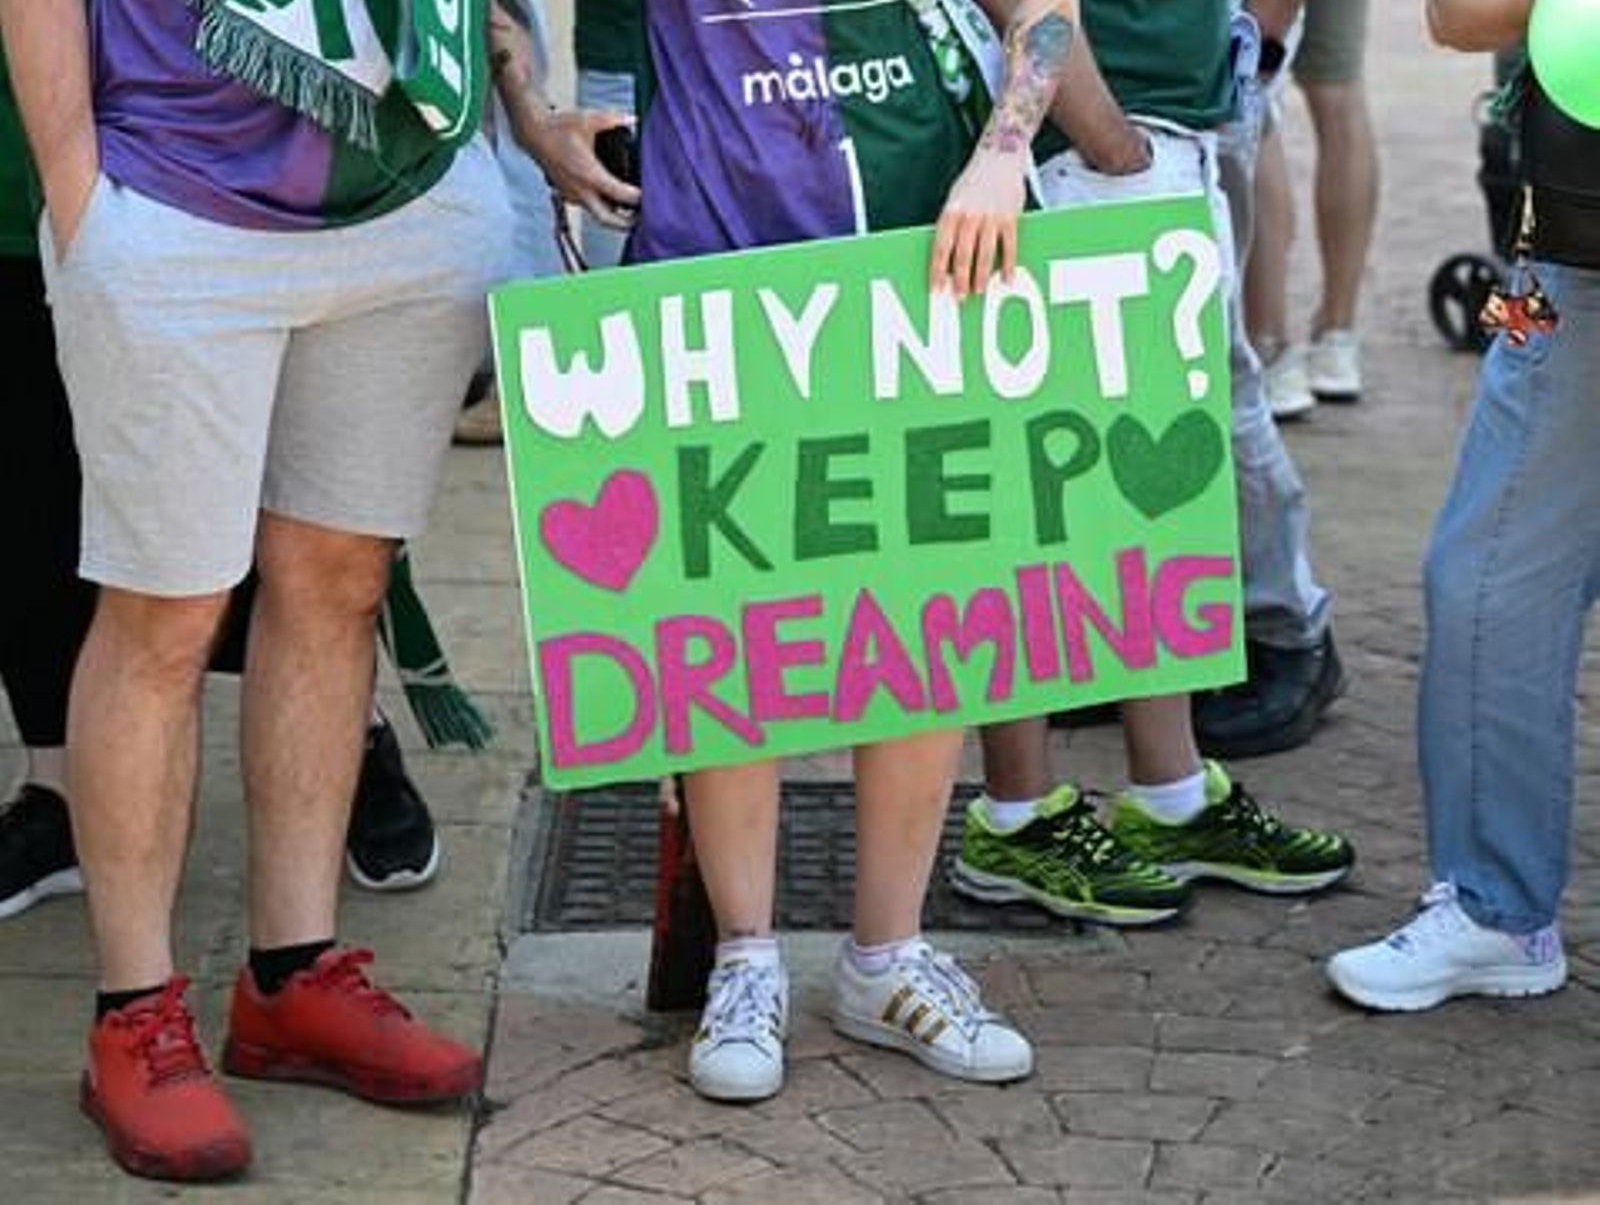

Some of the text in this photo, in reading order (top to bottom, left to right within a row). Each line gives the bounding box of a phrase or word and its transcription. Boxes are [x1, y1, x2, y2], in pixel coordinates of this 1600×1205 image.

[519, 228, 1221, 439] WHY NOT?
[676, 410, 1102, 580] KEEP
[538, 547, 1234, 769] DREAMING
